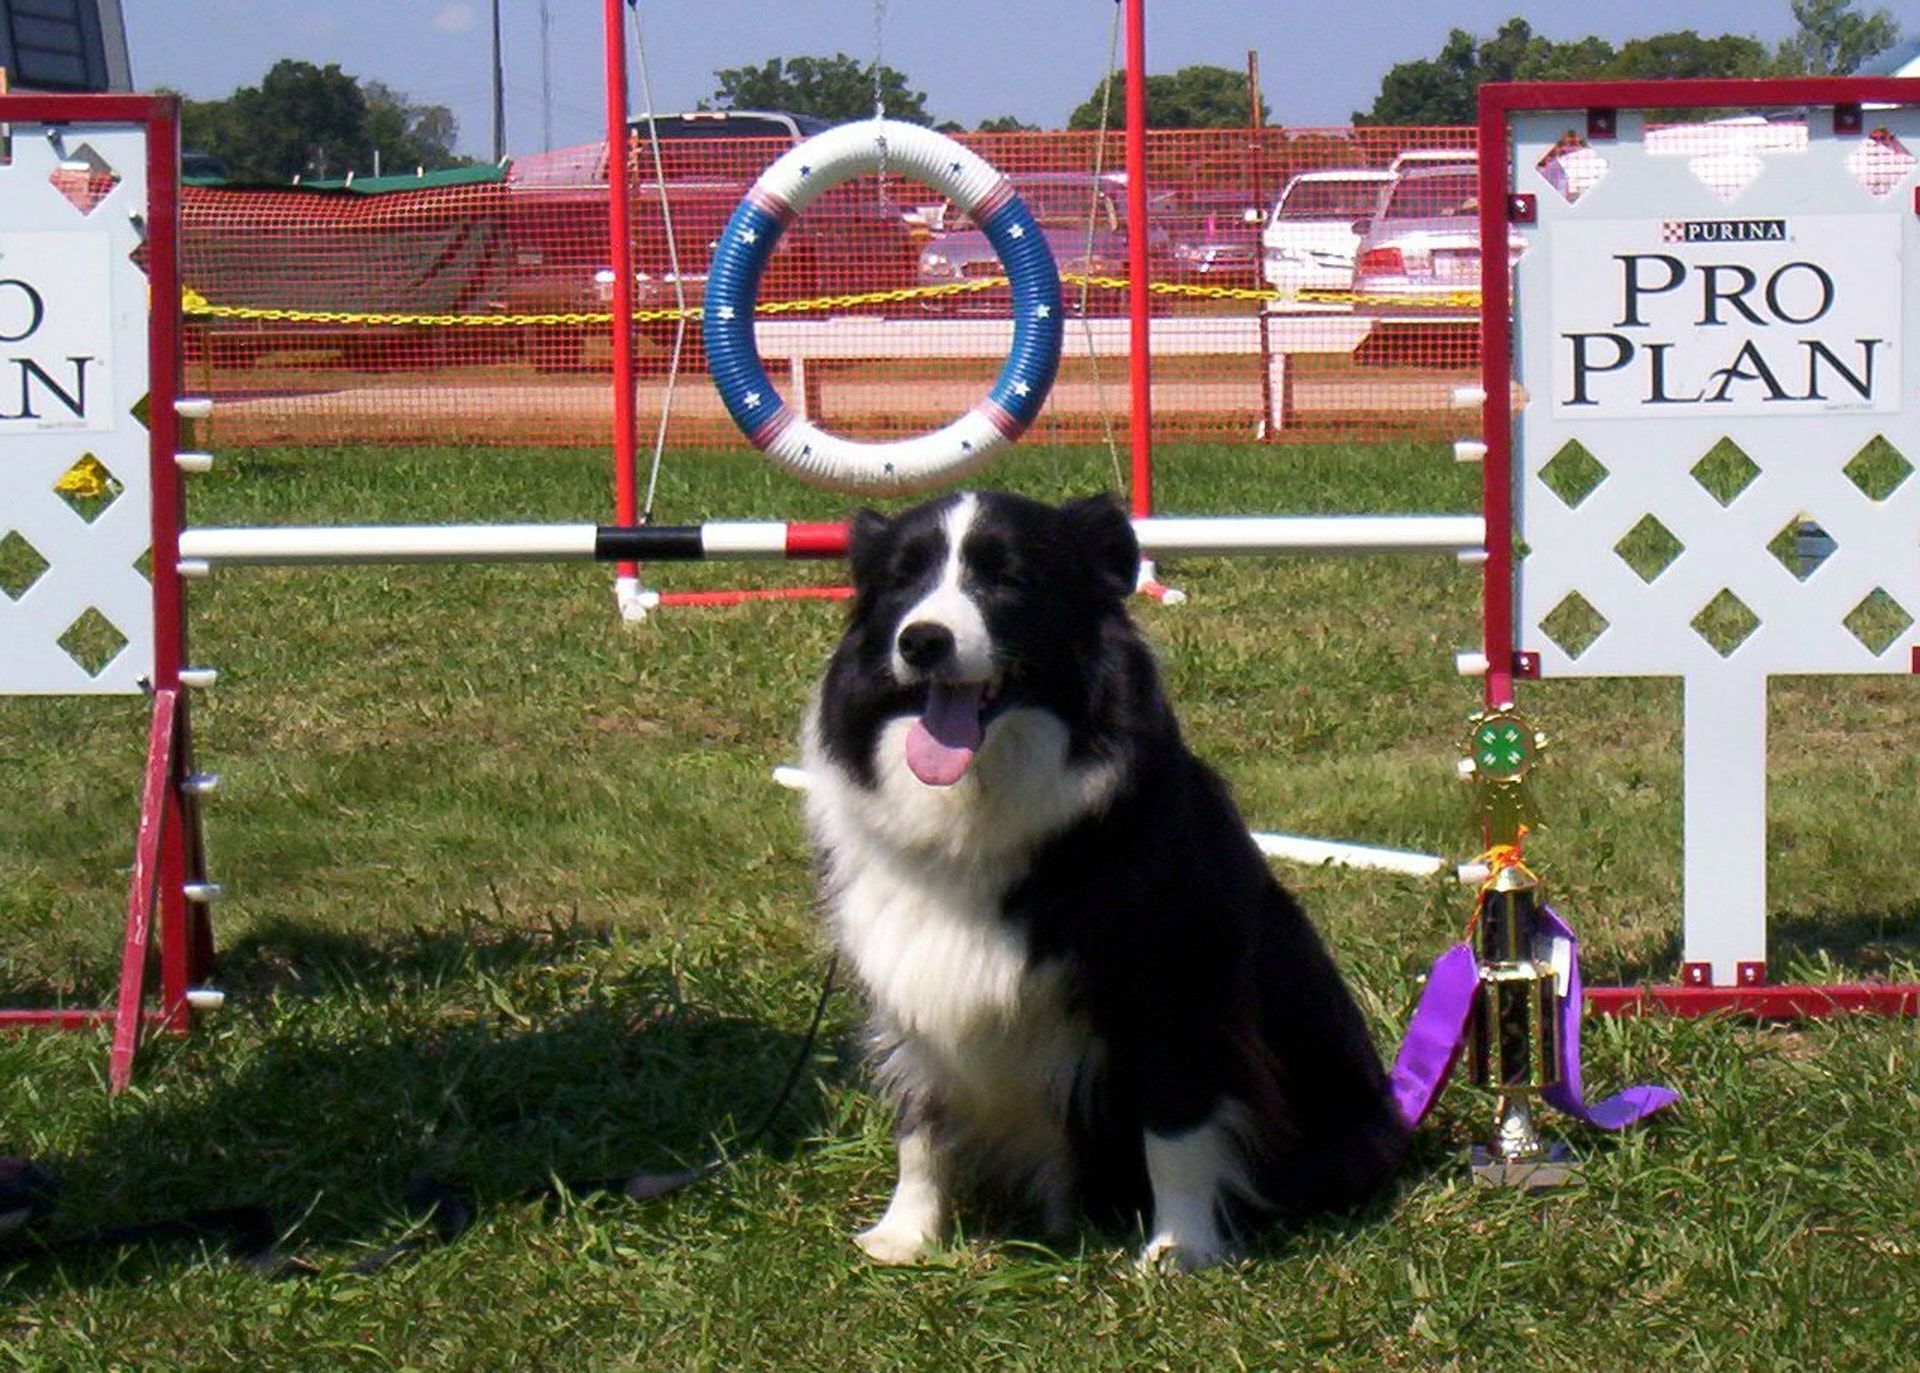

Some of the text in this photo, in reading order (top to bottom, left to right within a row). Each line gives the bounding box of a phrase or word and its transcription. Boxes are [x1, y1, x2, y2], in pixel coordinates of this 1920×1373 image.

[1688, 223, 1784, 241] PURINA
[1612, 254, 1835, 327] PRO
[0, 356, 95, 419] N
[1561, 332, 1884, 406] PLAN
